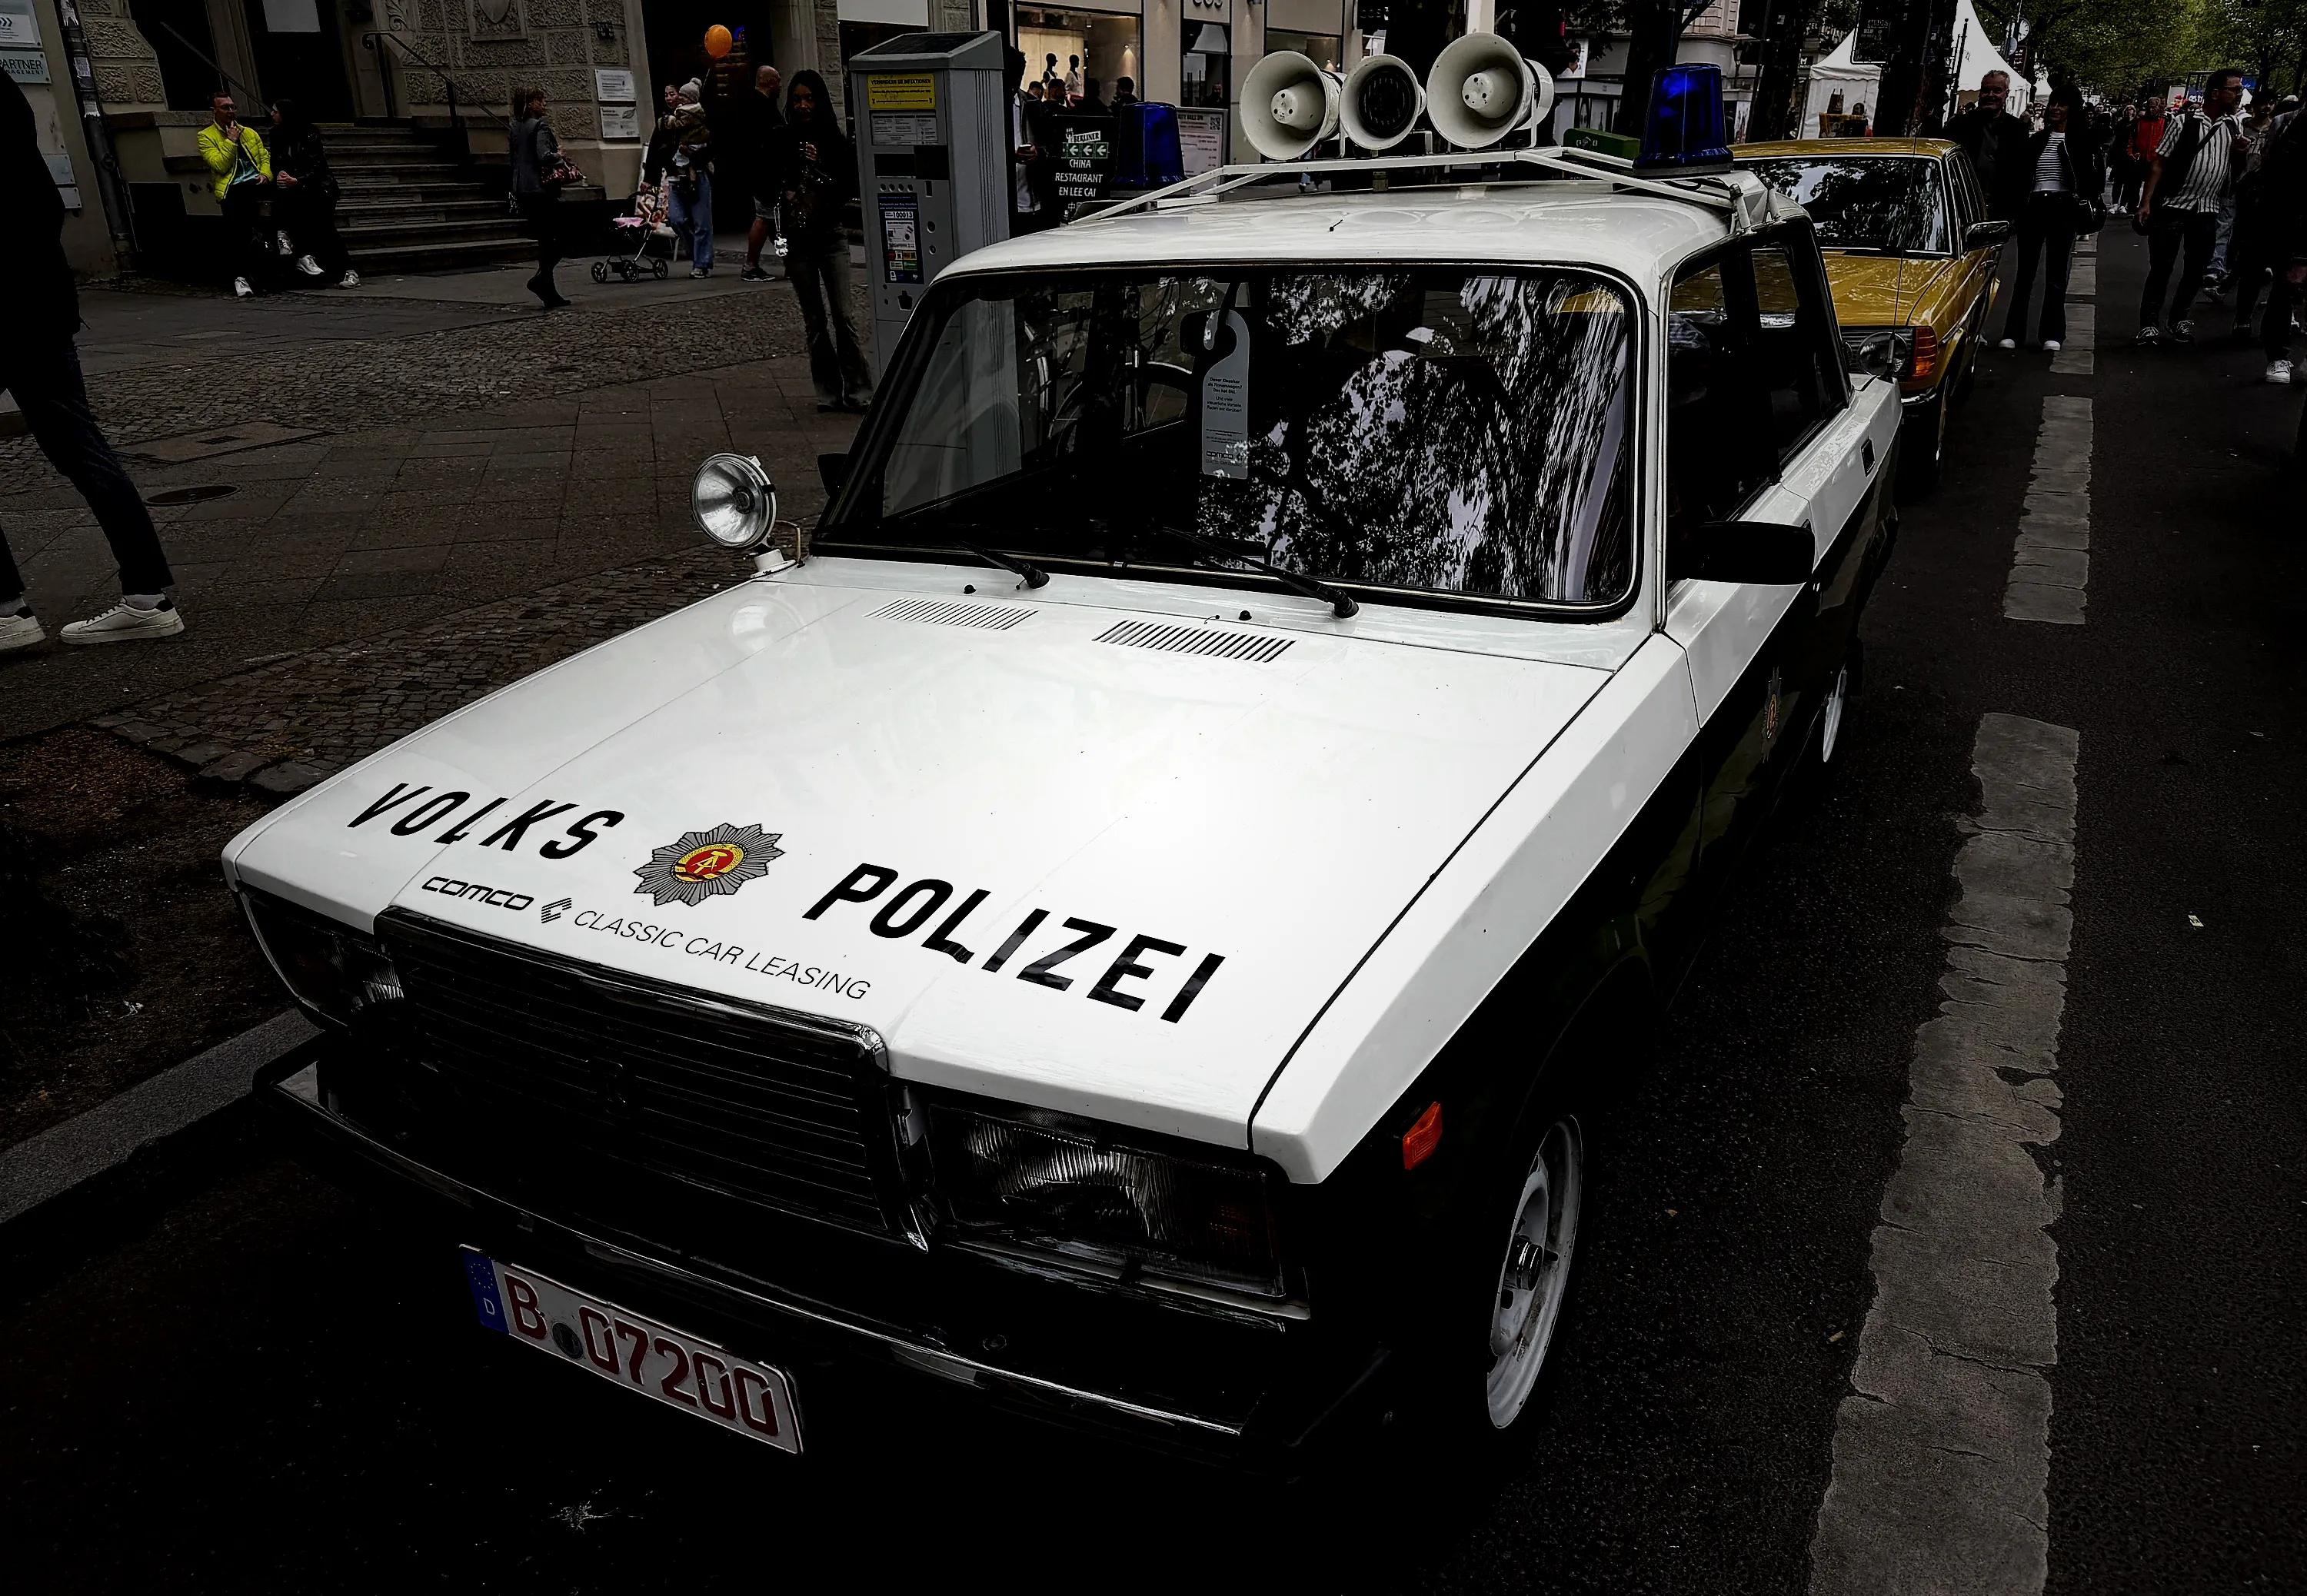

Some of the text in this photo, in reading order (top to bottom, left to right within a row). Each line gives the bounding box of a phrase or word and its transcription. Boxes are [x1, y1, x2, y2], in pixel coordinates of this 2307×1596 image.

[0, 58, 43, 70] ARTNER
[1069, 158, 1092, 168] CHINA
[1054, 172, 1104, 184] RESTAURANT
[1058, 186, 1097, 198] EN LEE CAI
[347, 783, 1225, 1024] VOLKS POLIZEI
[574, 910, 684, 948] CLASSIC
[684, 936, 744, 966] CAR
[745, 952, 871, 1000] LEASING
[483, 1296, 495, 1315] D
[504, 1271, 780, 1437] B 07200
